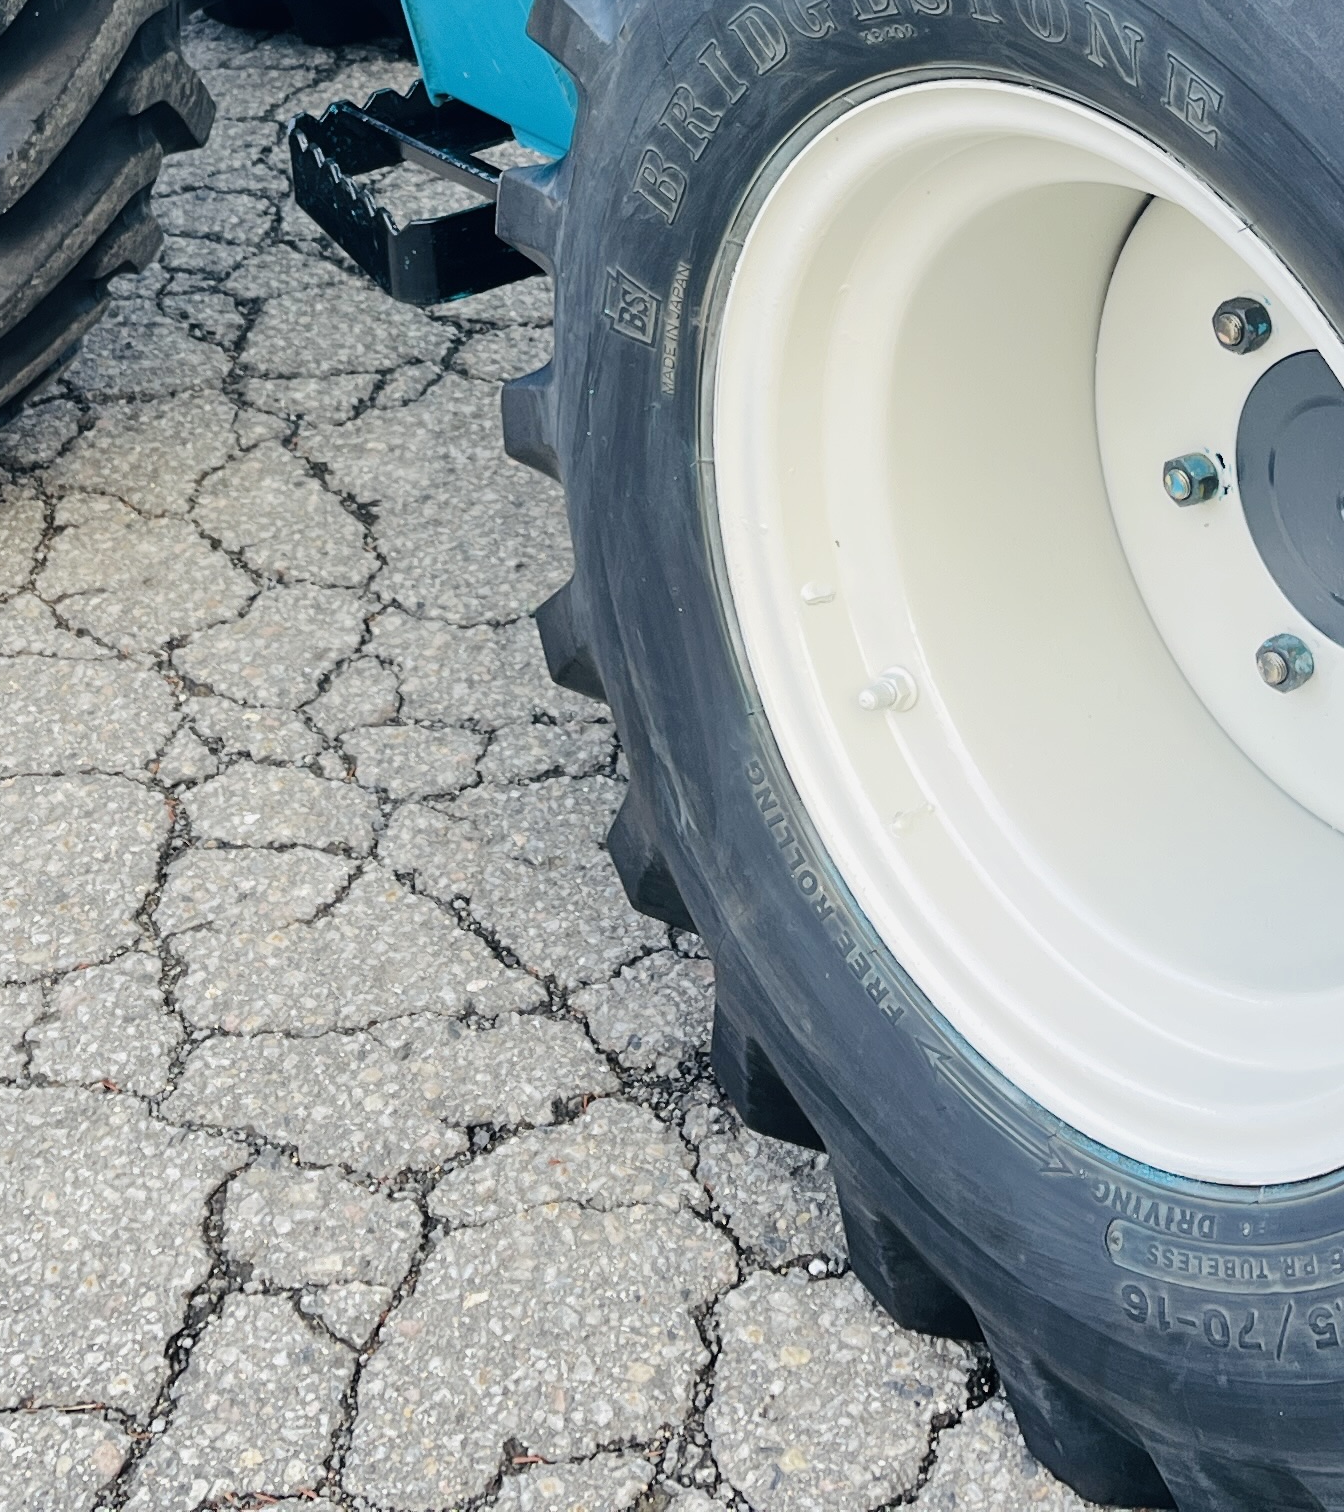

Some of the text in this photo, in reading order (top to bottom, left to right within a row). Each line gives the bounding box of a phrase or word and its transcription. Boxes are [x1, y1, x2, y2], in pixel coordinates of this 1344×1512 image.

[661, 261, 692, 397] MADE IN JAPAN
[744, 759, 905, 1027] FREE ROLLING
[1092, 1181, 1217, 1239] DRIVING
[1147, 1243, 1269, 1280] TUBELESS
